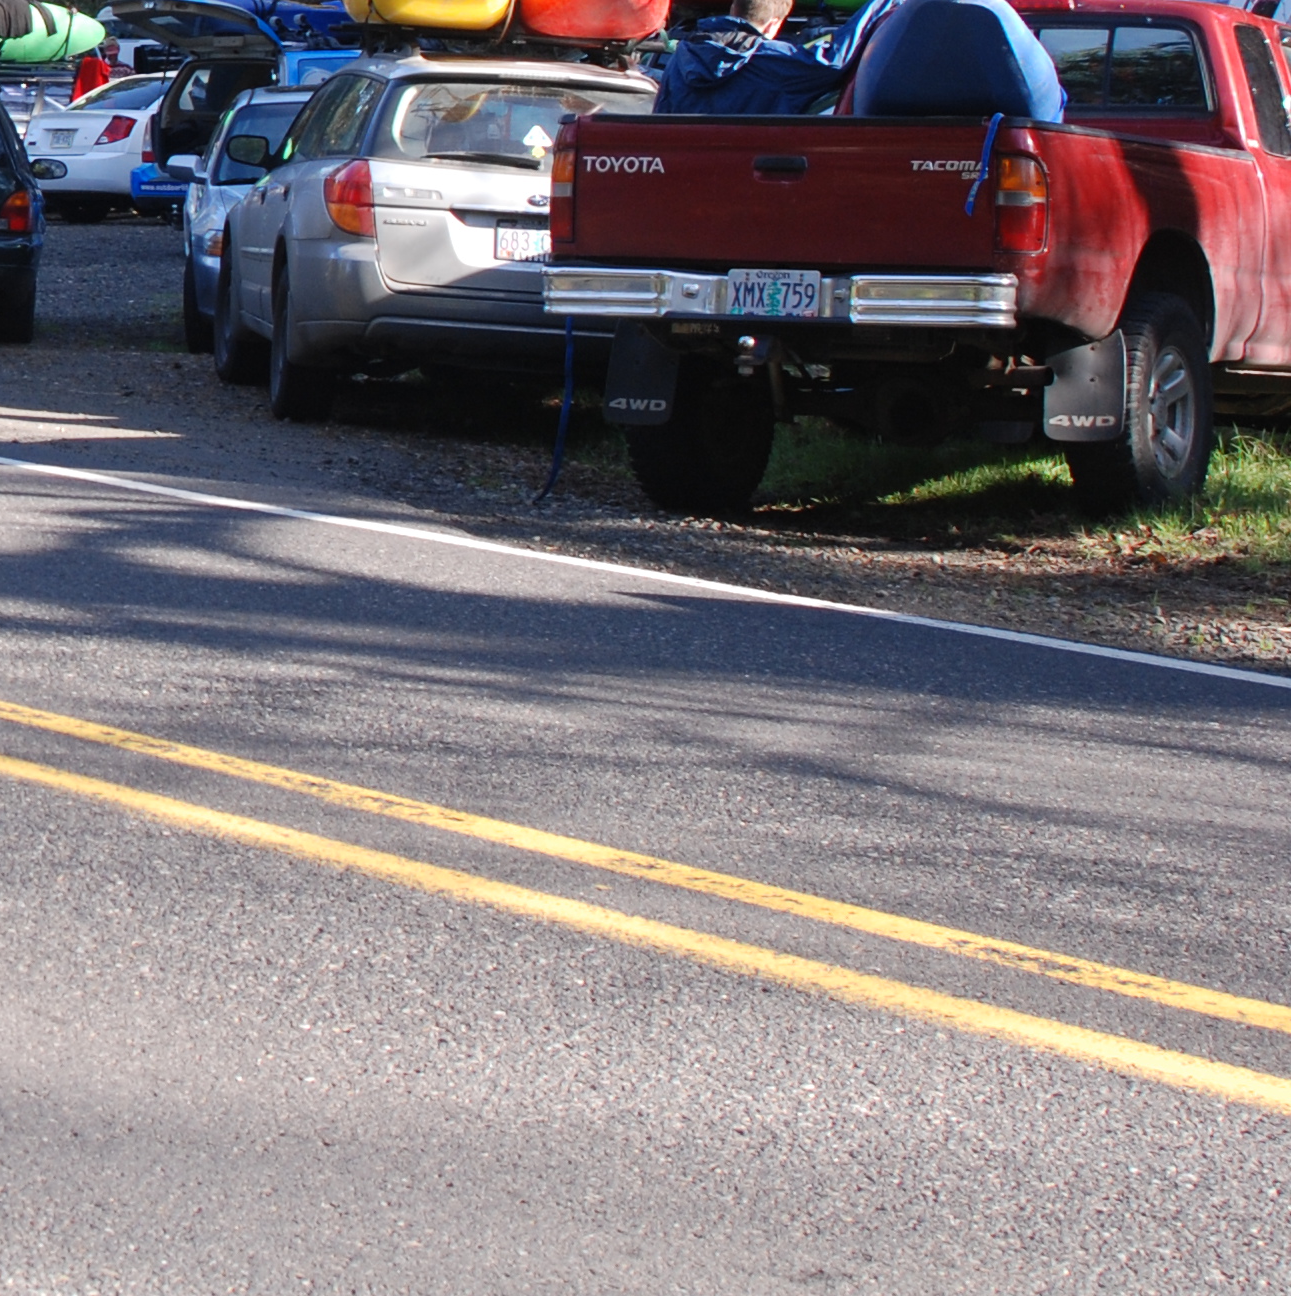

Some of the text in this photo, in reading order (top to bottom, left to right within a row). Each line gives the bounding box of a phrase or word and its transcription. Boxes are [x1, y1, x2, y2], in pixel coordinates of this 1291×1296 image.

[582, 155, 665, 174] TOYOTA
[961, 171, 988, 180] SR
[499, 230, 530, 251] 683
[756, 270, 791, 281] Oregon
[731, 281, 815, 308] XMX 759
[608, 397, 666, 412] 4WD
[1048, 414, 1116, 427] 4WD
